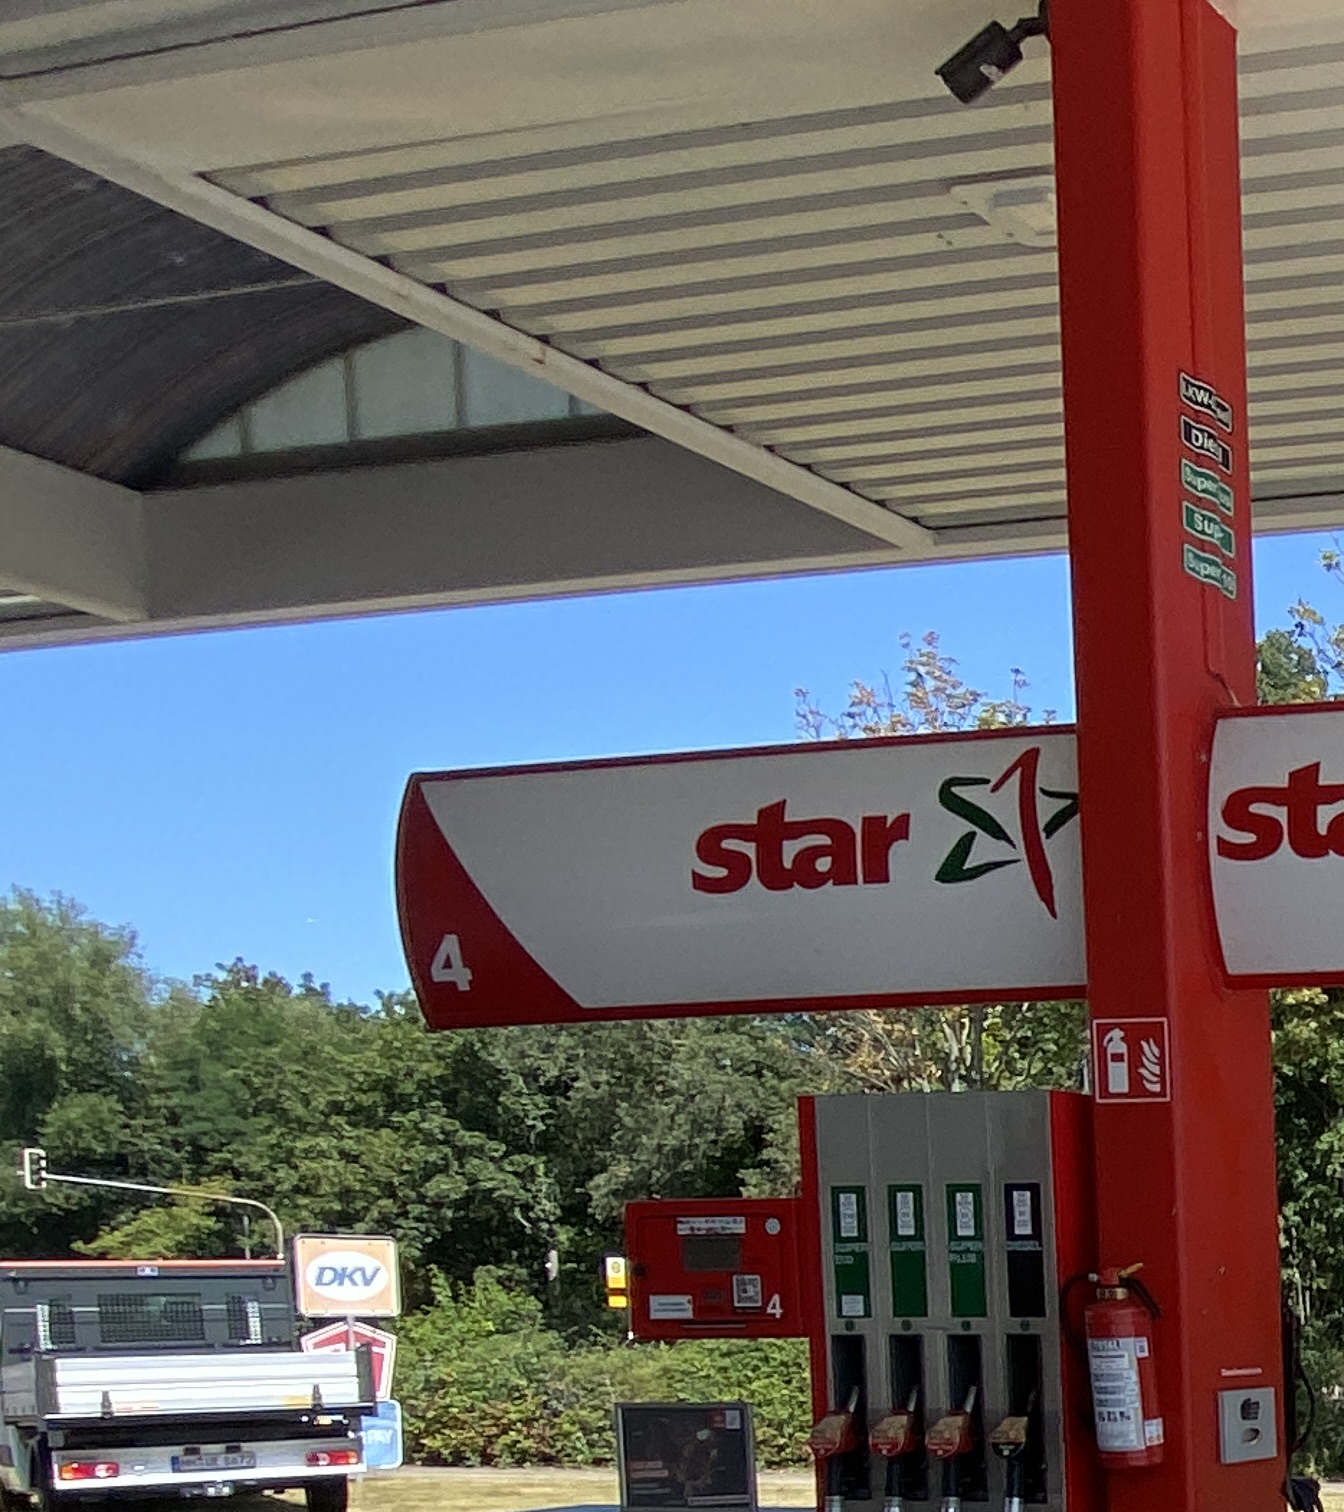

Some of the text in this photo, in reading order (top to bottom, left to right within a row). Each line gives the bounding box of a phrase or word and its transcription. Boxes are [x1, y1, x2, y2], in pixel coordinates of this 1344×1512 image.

[691, 800, 911, 896] star
[430, 935, 473, 993] 4
[315, 1265, 381, 1287] DKV
[765, 1293, 784, 1320] 4
